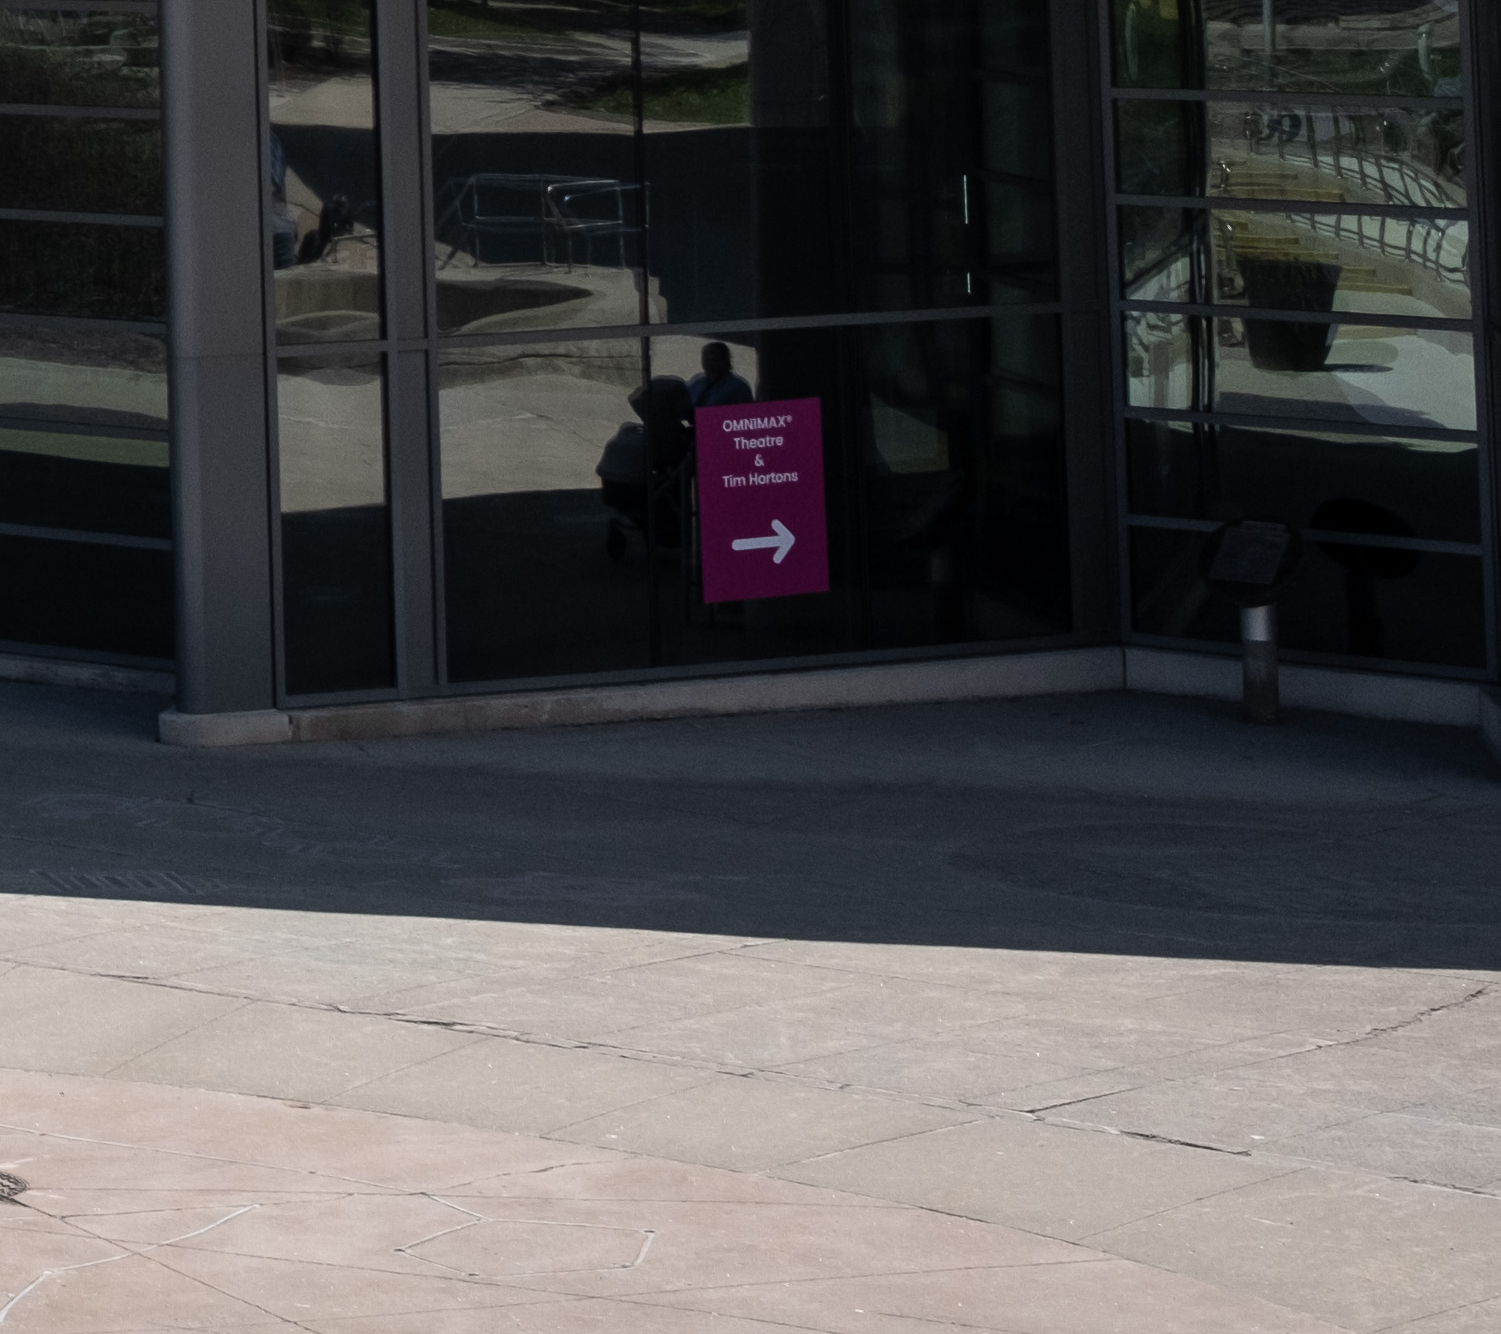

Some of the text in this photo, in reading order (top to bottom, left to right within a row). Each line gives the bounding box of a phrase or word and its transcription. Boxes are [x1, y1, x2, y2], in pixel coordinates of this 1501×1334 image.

[733, 435, 784, 450] Theatre
[754, 453, 765, 467] &
[722, 471, 799, 488] Tim Hortons
